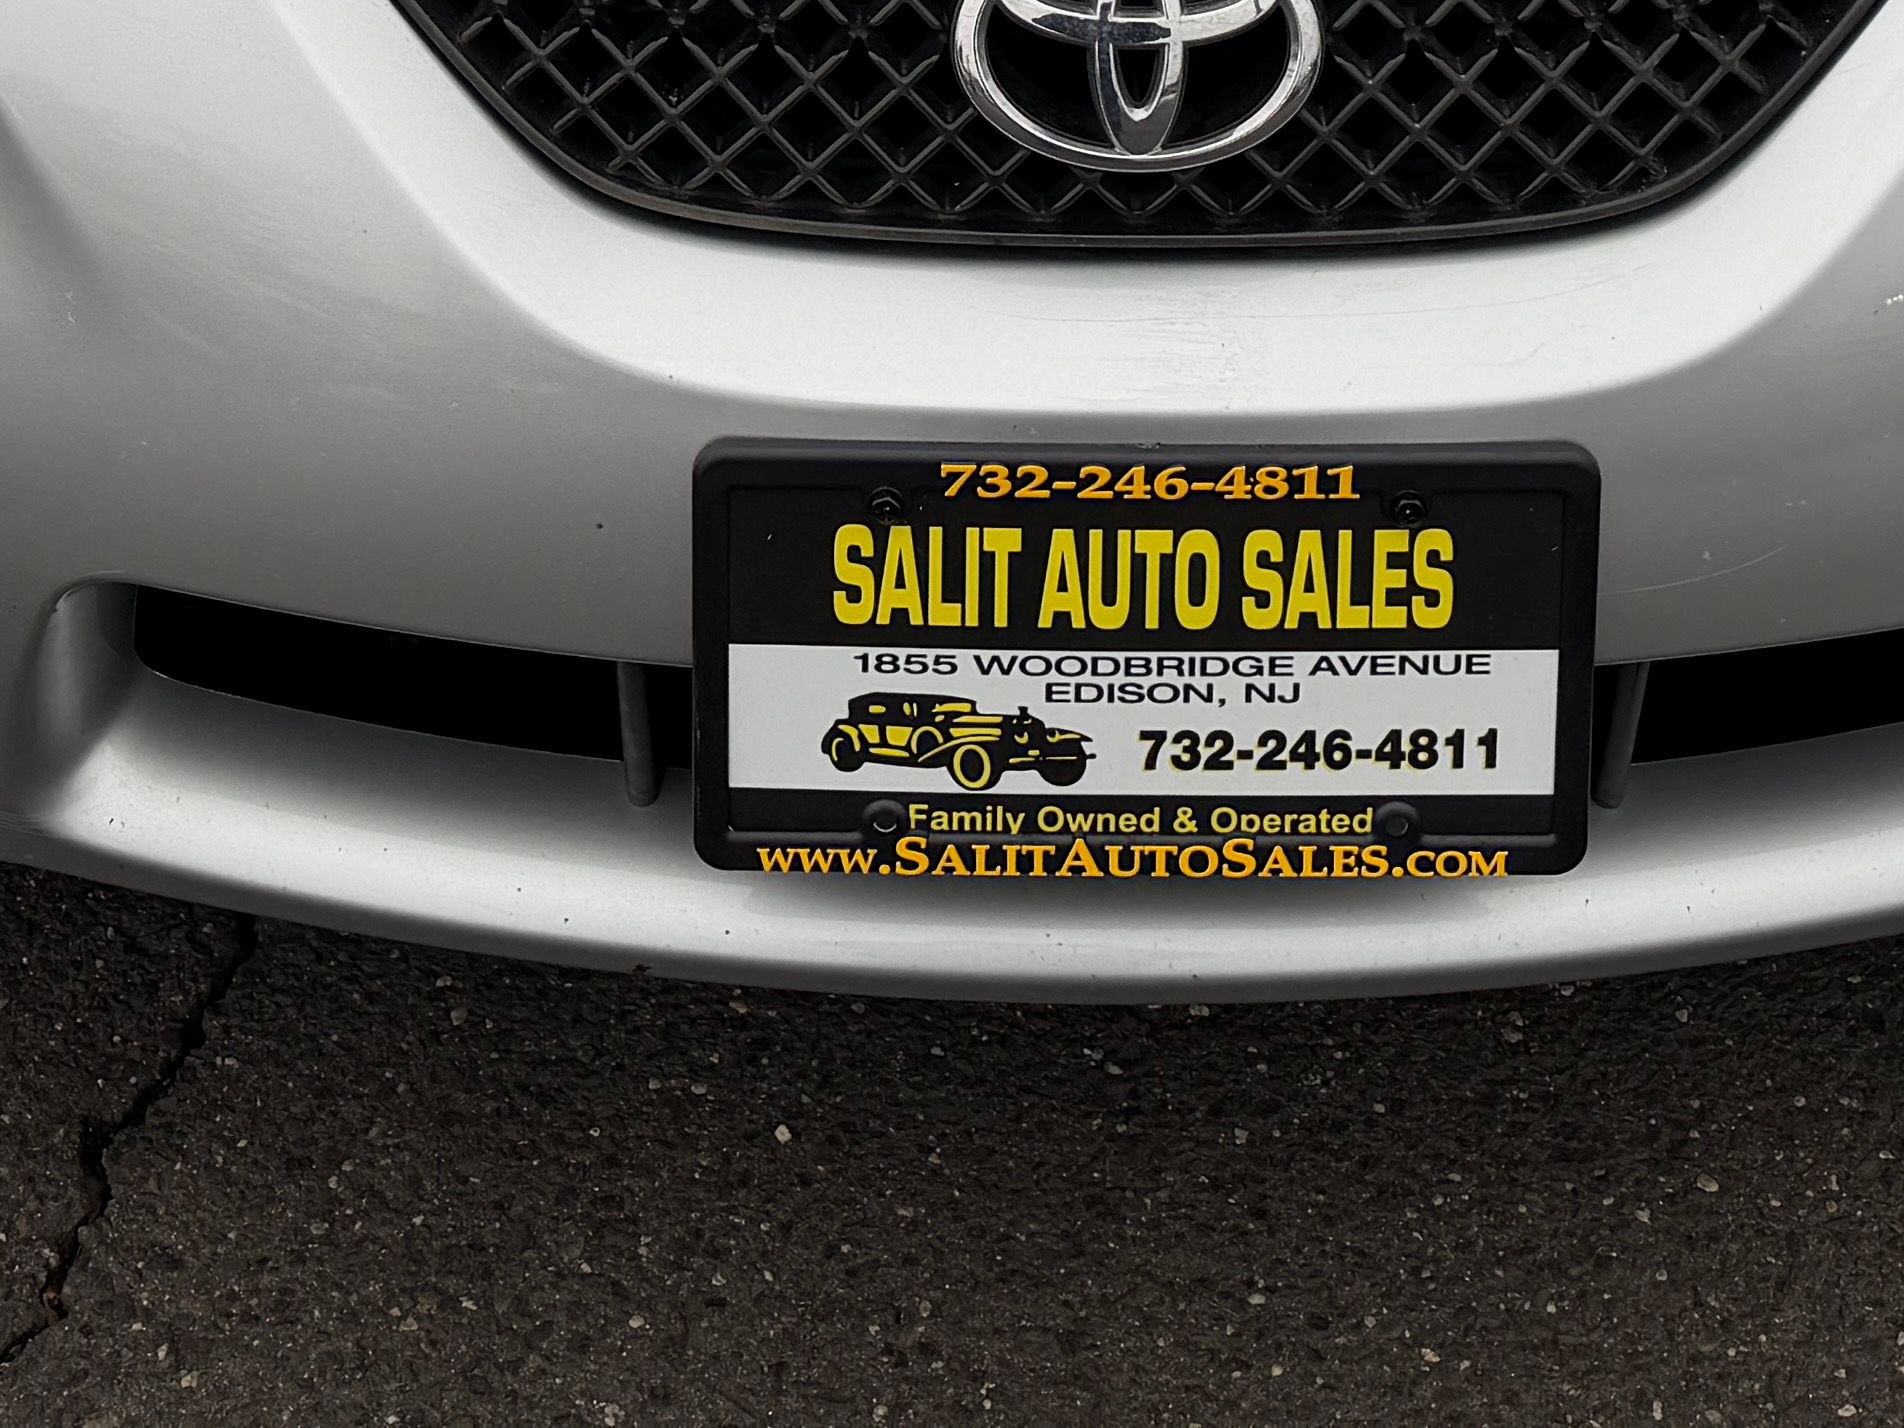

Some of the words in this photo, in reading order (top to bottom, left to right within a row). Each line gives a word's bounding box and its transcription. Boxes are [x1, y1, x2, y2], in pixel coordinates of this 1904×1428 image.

[940, 461, 1361, 501] 732-246-4811
[832, 523, 1023, 627] SALIT
[1037, 528, 1221, 631] AUTO
[1241, 527, 1455, 631] SALES
[853, 652, 959, 675] 1855
[972, 654, 1295, 678] WOODBRIDGE
[1307, 653, 1492, 677] AVENUE
[1044, 681, 1227, 708] EDISON,
[1244, 682, 1302, 704] NJ
[1137, 727, 1499, 772] 732-246-4811
[907, 803, 1026, 835] Family
[1037, 805, 1161, 833] Owned
[1172, 807, 1198, 833] &
[1210, 807, 1374, 835] Operated
